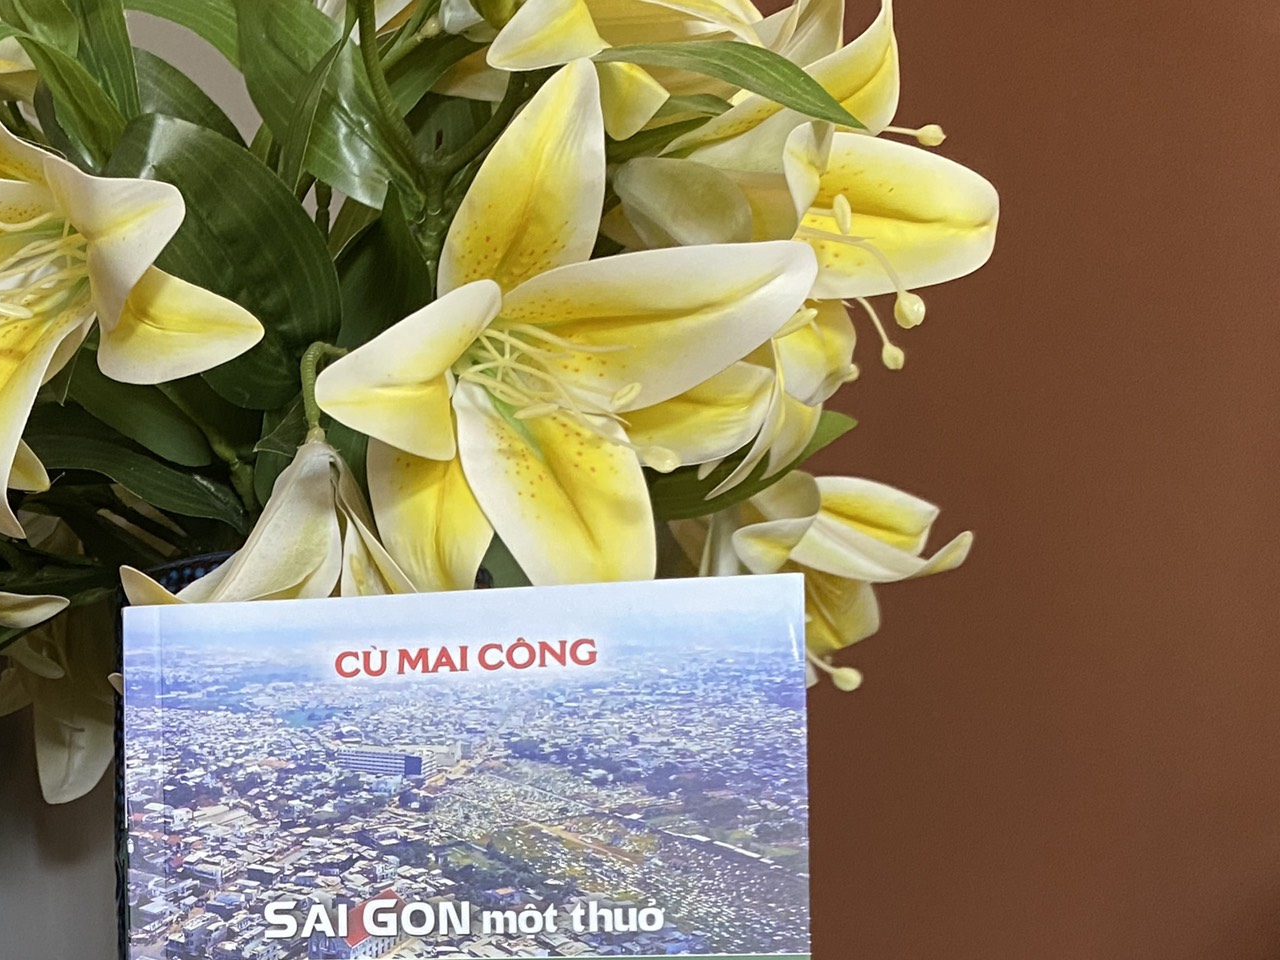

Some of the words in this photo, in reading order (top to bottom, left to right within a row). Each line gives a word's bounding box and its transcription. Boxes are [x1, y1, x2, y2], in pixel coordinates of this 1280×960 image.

[335, 645, 388, 678] CÙ
[397, 646, 469, 675] MAI
[477, 637, 597, 671] CÔNG
[483, 903, 558, 938] một
[571, 897, 665, 932] thuở
